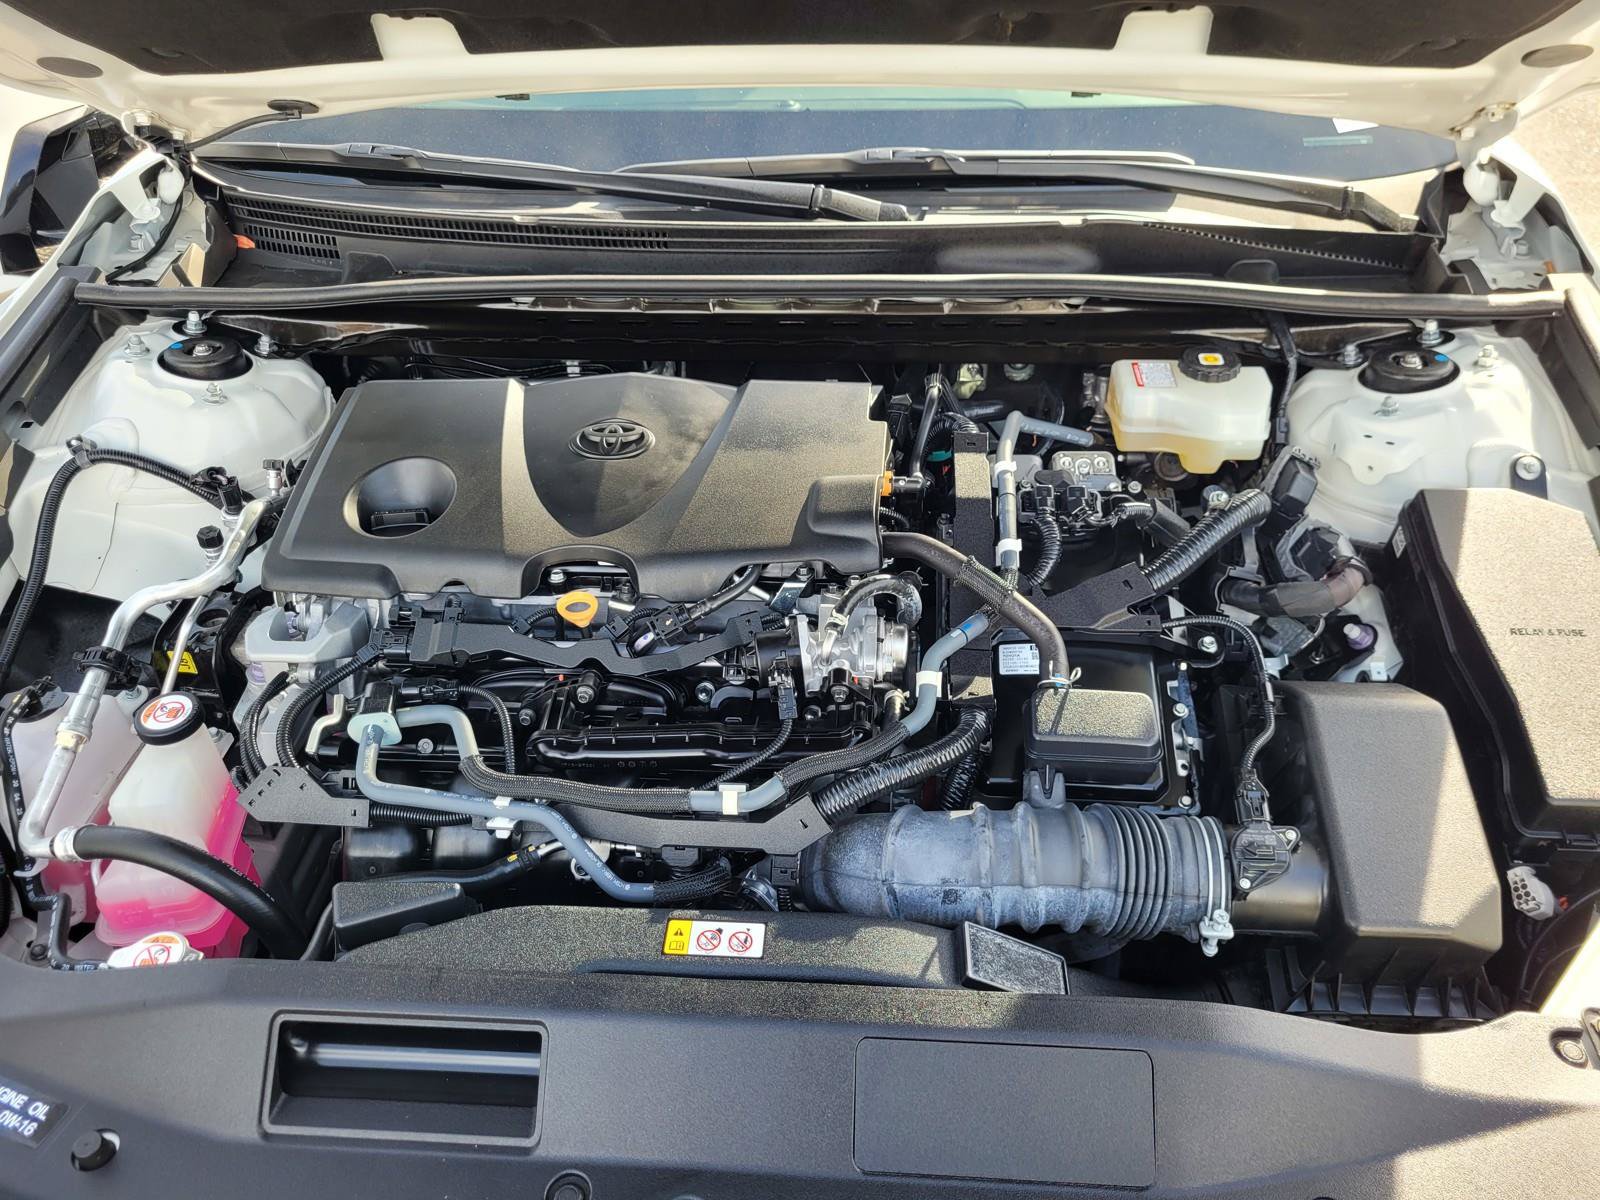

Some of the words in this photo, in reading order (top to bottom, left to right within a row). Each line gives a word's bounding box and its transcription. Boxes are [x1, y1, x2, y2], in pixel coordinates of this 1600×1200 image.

[1510, 627, 1544, 636] RELAY
[1547, 628, 1555, 636] &
[1557, 628, 1587, 637] FUSE
[0, 1086, 29, 1109] GINE
[28, 1101, 50, 1121] OIL
[0, 1110, 38, 1136] 0W-16
